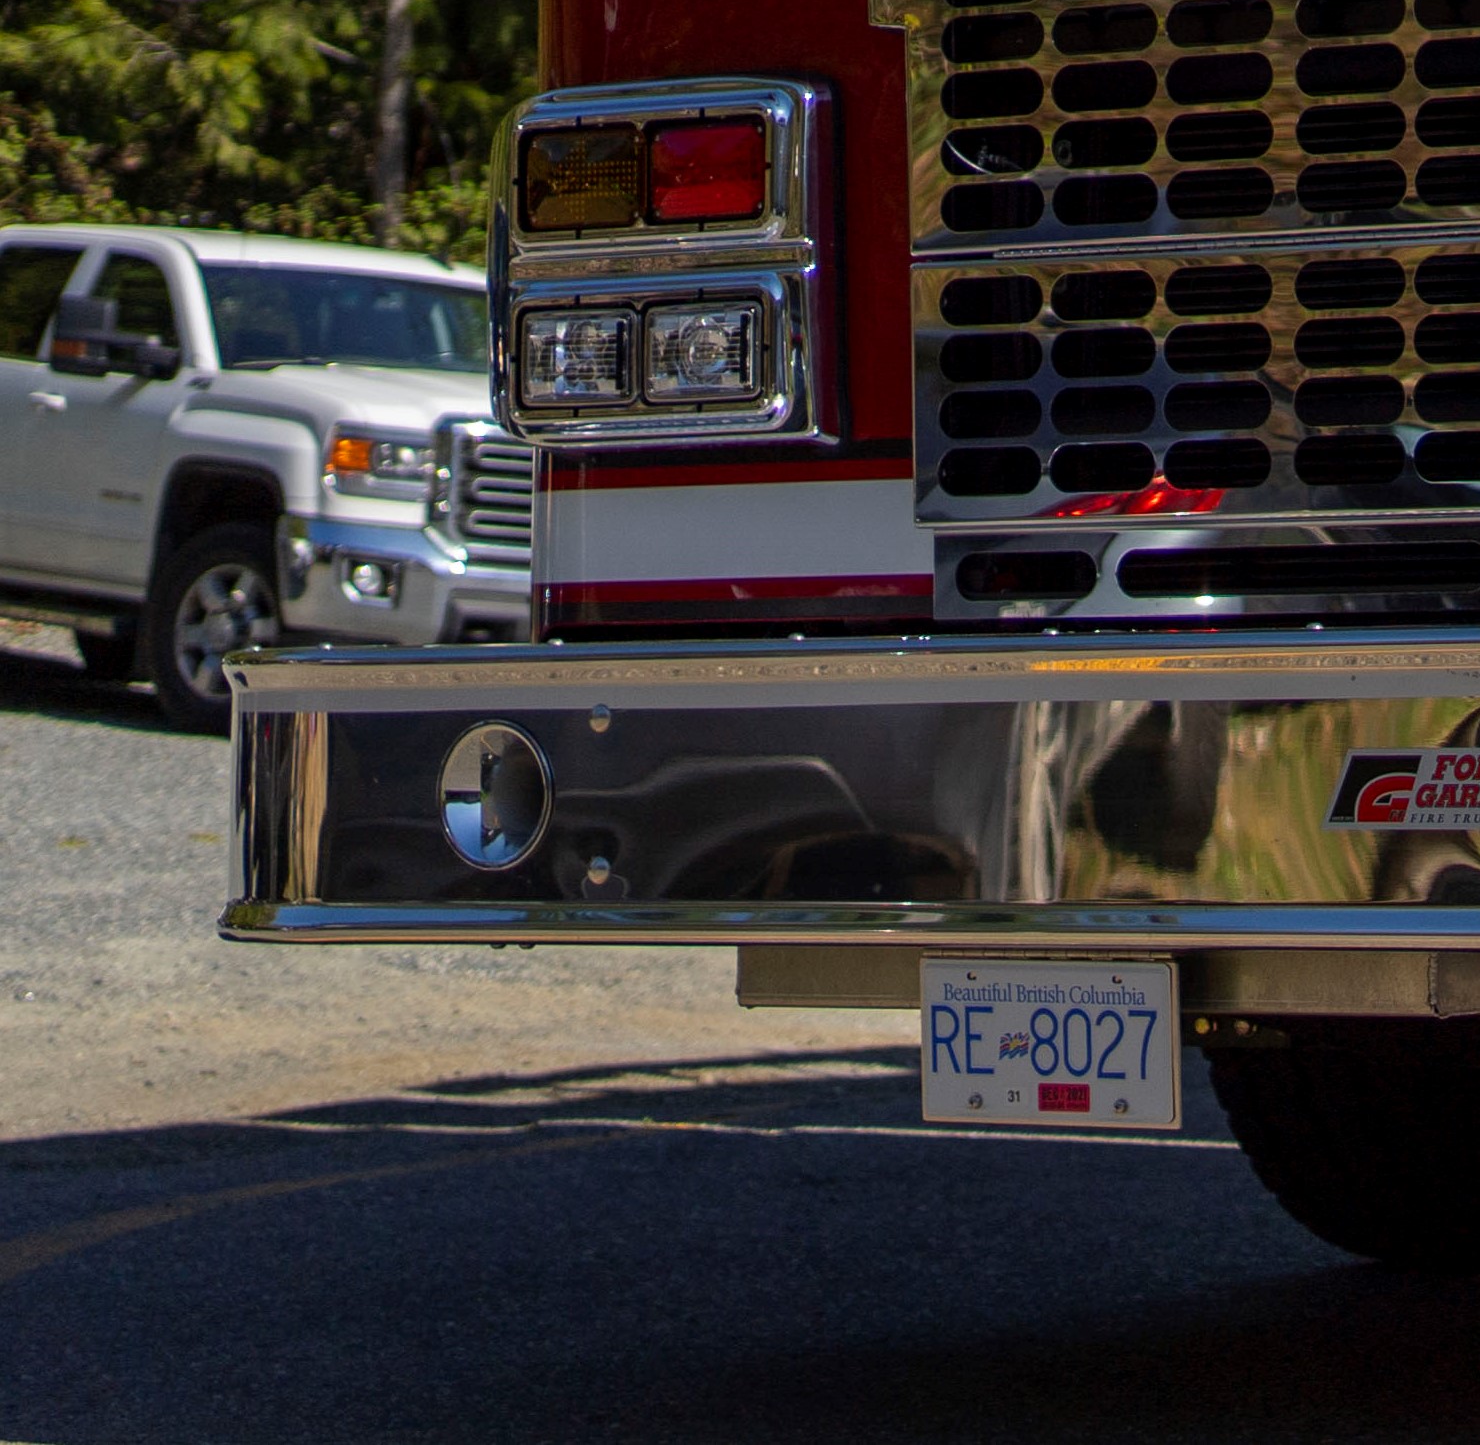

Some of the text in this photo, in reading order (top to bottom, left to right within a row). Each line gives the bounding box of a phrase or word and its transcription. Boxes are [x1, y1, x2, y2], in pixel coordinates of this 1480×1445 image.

[1410, 813, 1445, 824] FIRE
[944, 982, 1146, 1006] Beautiful British Columbia
[931, 1005, 1157, 1080] RE 8027
[1007, 1090, 1021, 1103] 31
